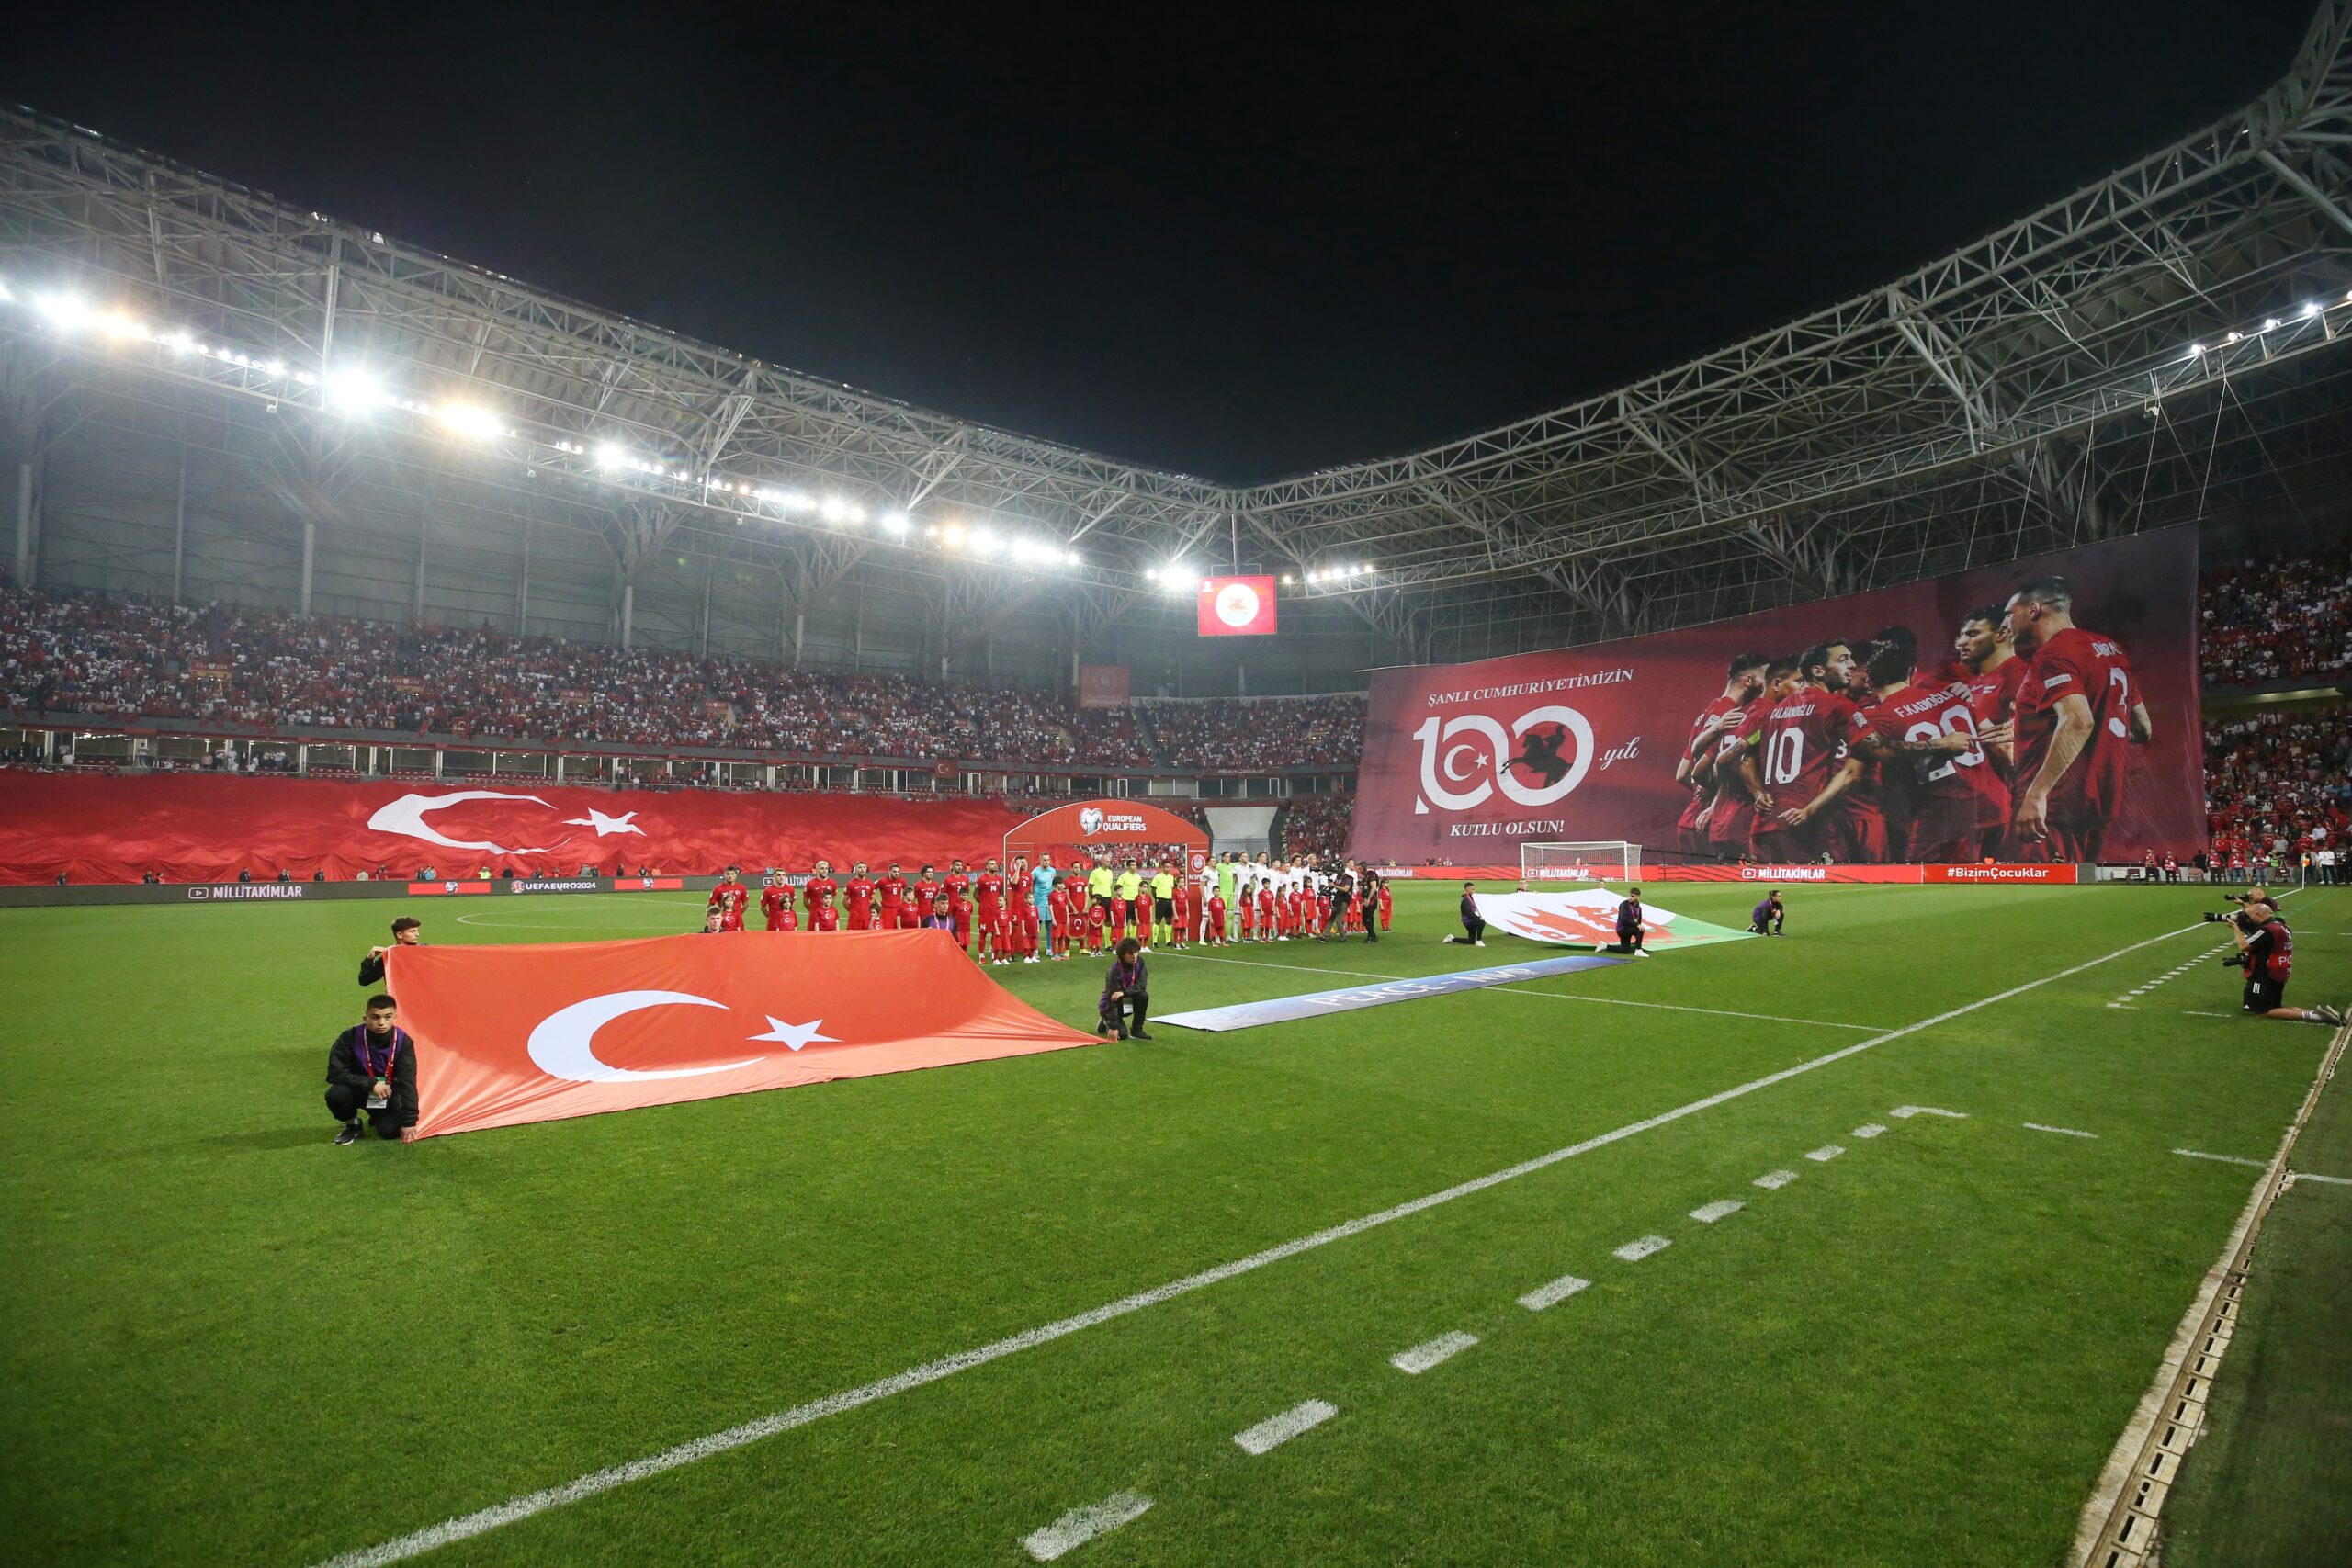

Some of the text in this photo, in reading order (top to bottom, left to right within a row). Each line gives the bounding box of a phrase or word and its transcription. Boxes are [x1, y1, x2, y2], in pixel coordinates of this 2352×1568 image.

[1428, 669, 1634, 708] ŞANLI CUMHURİYETİMİZİN
[1412, 705, 1595, 815] 100
[1764, 726, 1804, 785] 10
[1107, 815, 1142, 823] EUROPEAN
[1103, 822, 1147, 832] QUALIFIERS
[1450, 820, 1565, 837] KUTLU OLSUN!
[1758, 866, 1826, 880] MİLLİTAKİMLAR
[1946, 867, 2049, 880] #BizimÇocuklar
[213, 884, 302, 898] MİLLİTAKİMLAR
[861, 889, 866, 897] 5
[1305, 983, 1448, 1007] PEACE
